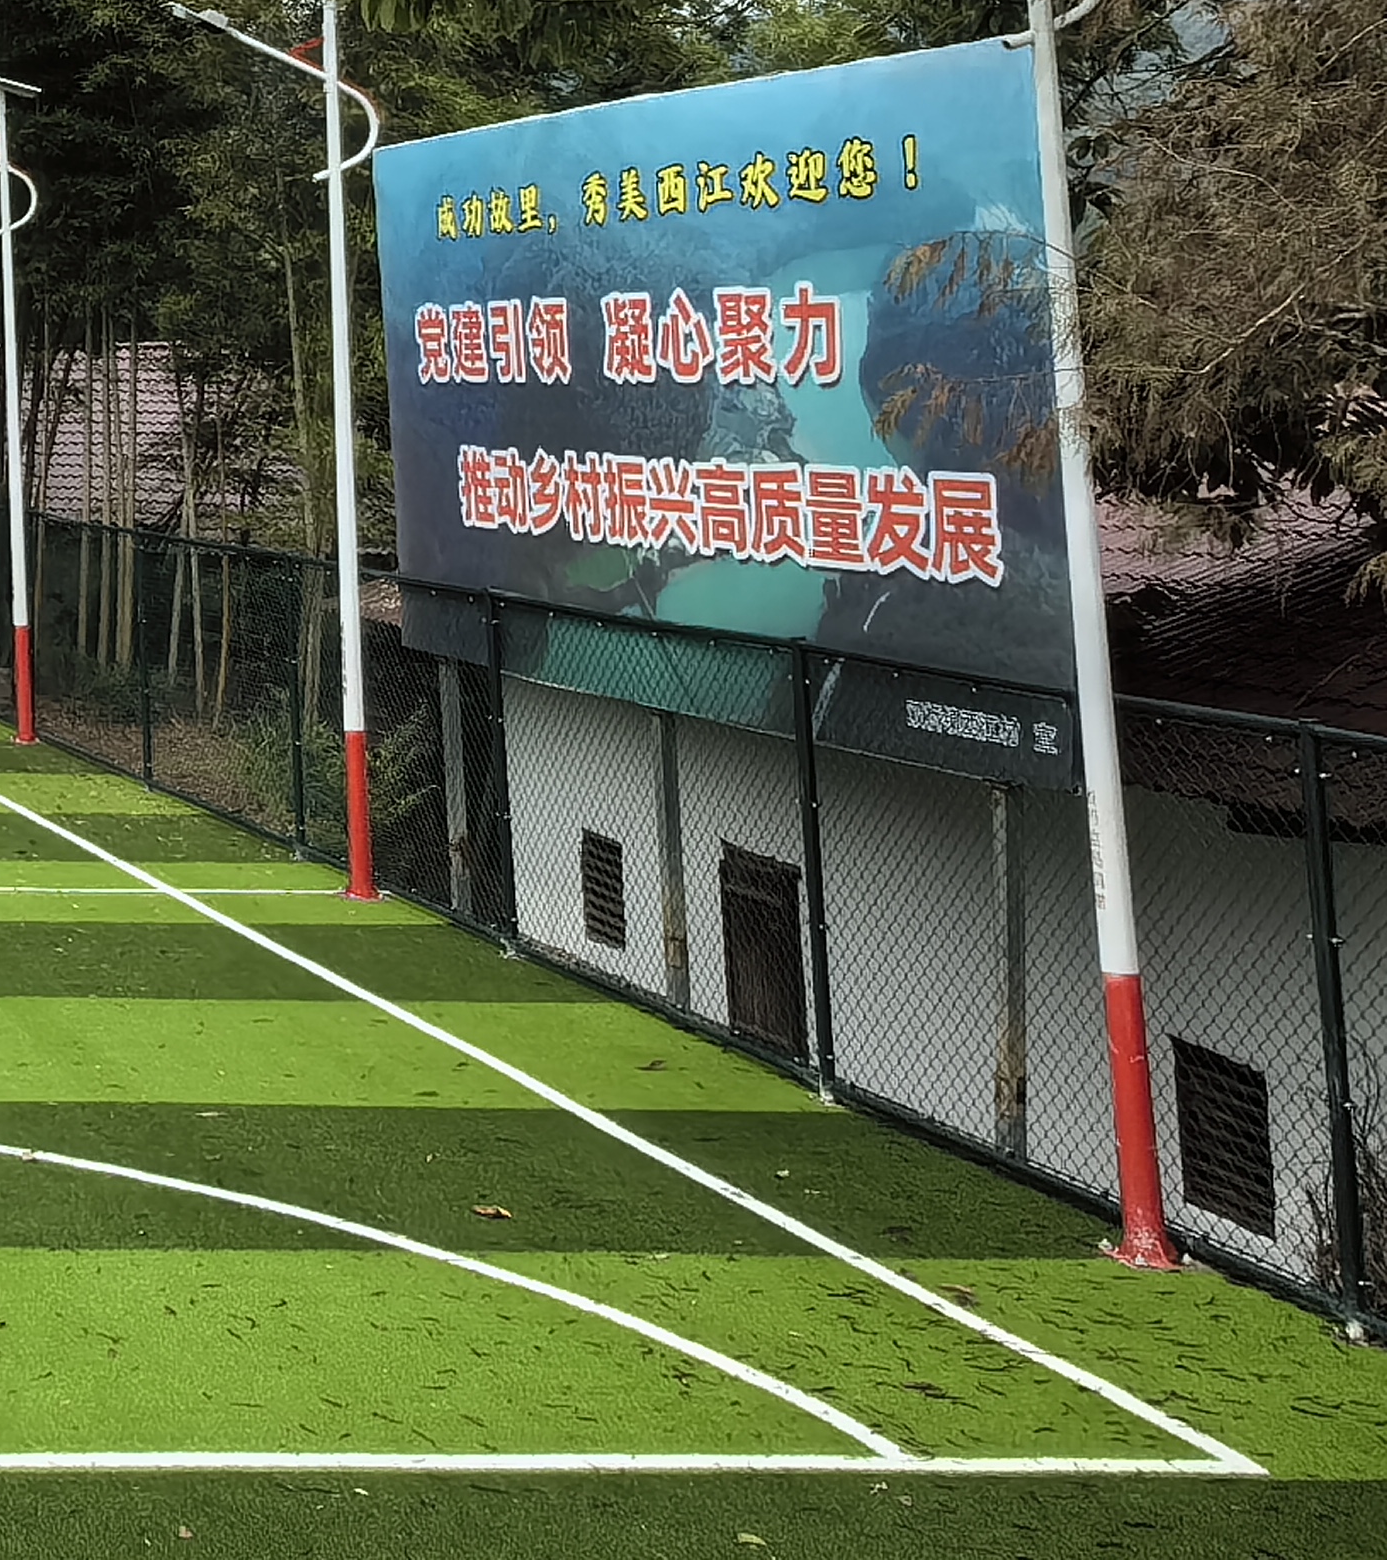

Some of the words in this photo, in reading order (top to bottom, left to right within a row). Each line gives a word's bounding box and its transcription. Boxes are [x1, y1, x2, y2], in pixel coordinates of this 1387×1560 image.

[415, 297, 571, 385] 党建引领
[601, 281, 843, 385] 凝心聚力
[457, 446, 1003, 586] 推动乡村振兴高质量发展
